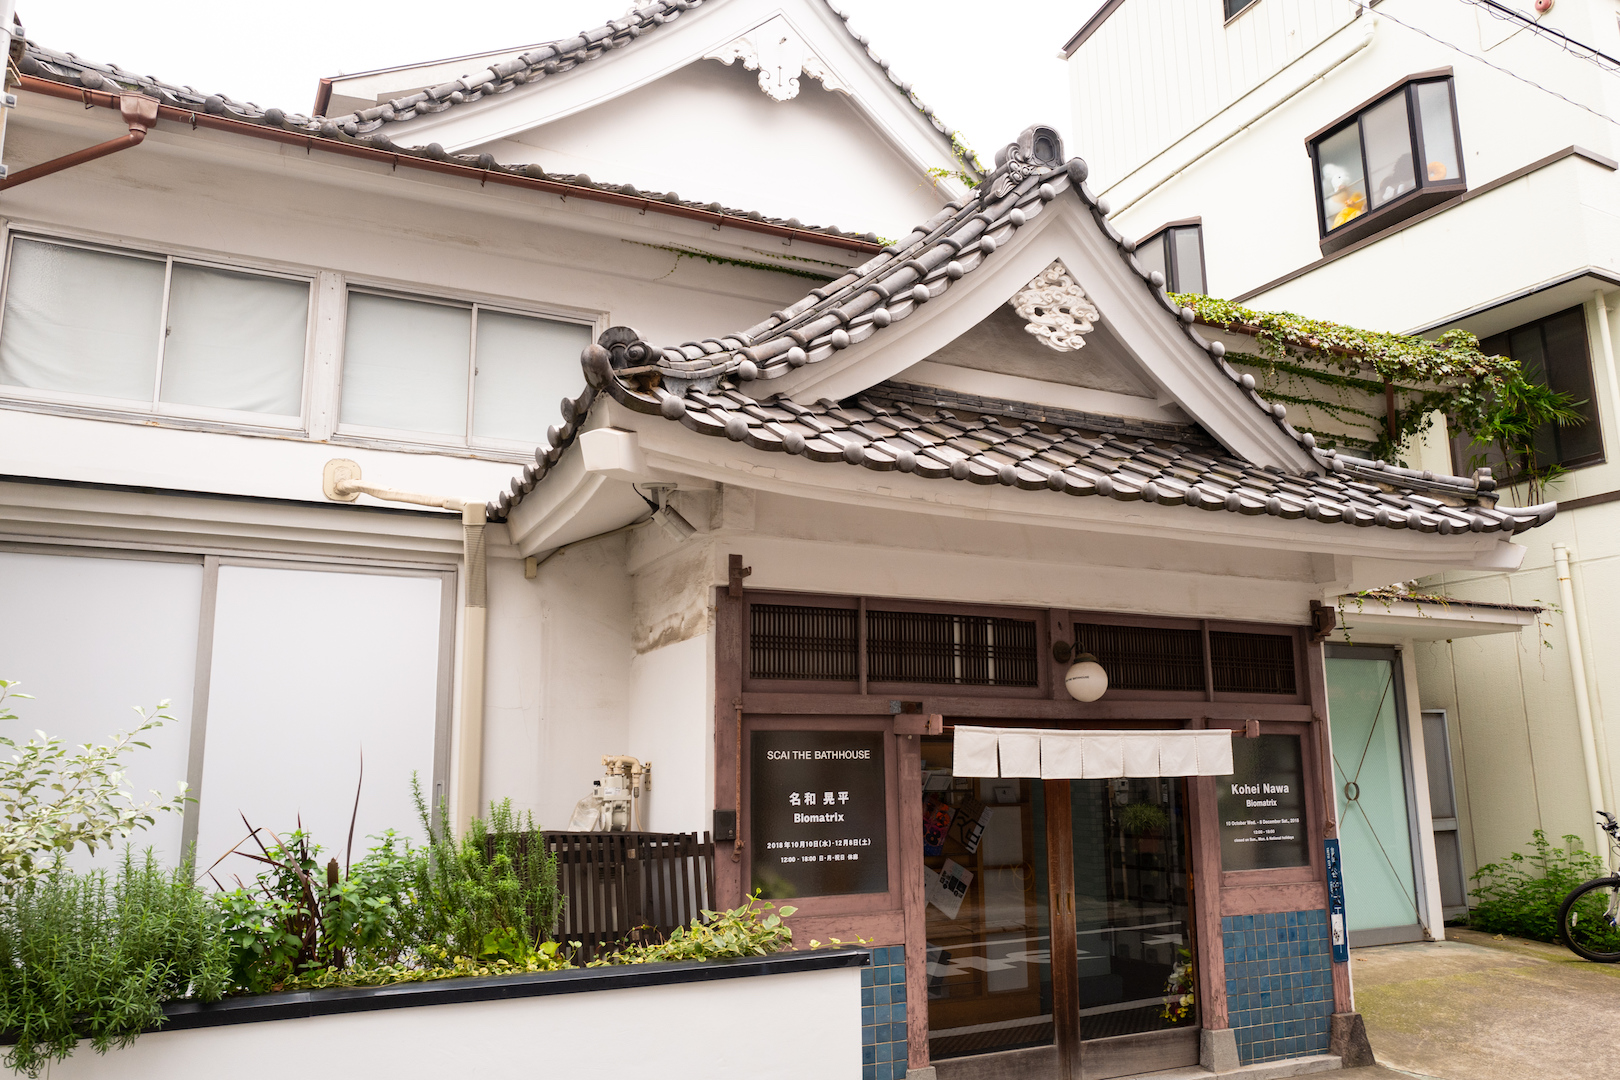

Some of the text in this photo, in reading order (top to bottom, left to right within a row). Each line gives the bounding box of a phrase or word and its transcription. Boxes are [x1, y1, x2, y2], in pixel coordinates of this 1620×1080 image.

[766, 750, 871, 760] SCAI THE BATHHOUSE
[1231, 782, 1290, 795] Kohei Nawa
[789, 791, 850, 806] 名和 晃平
[1246, 799, 1278, 808] Biomatrix
[793, 812, 845, 823] Biomatrix
